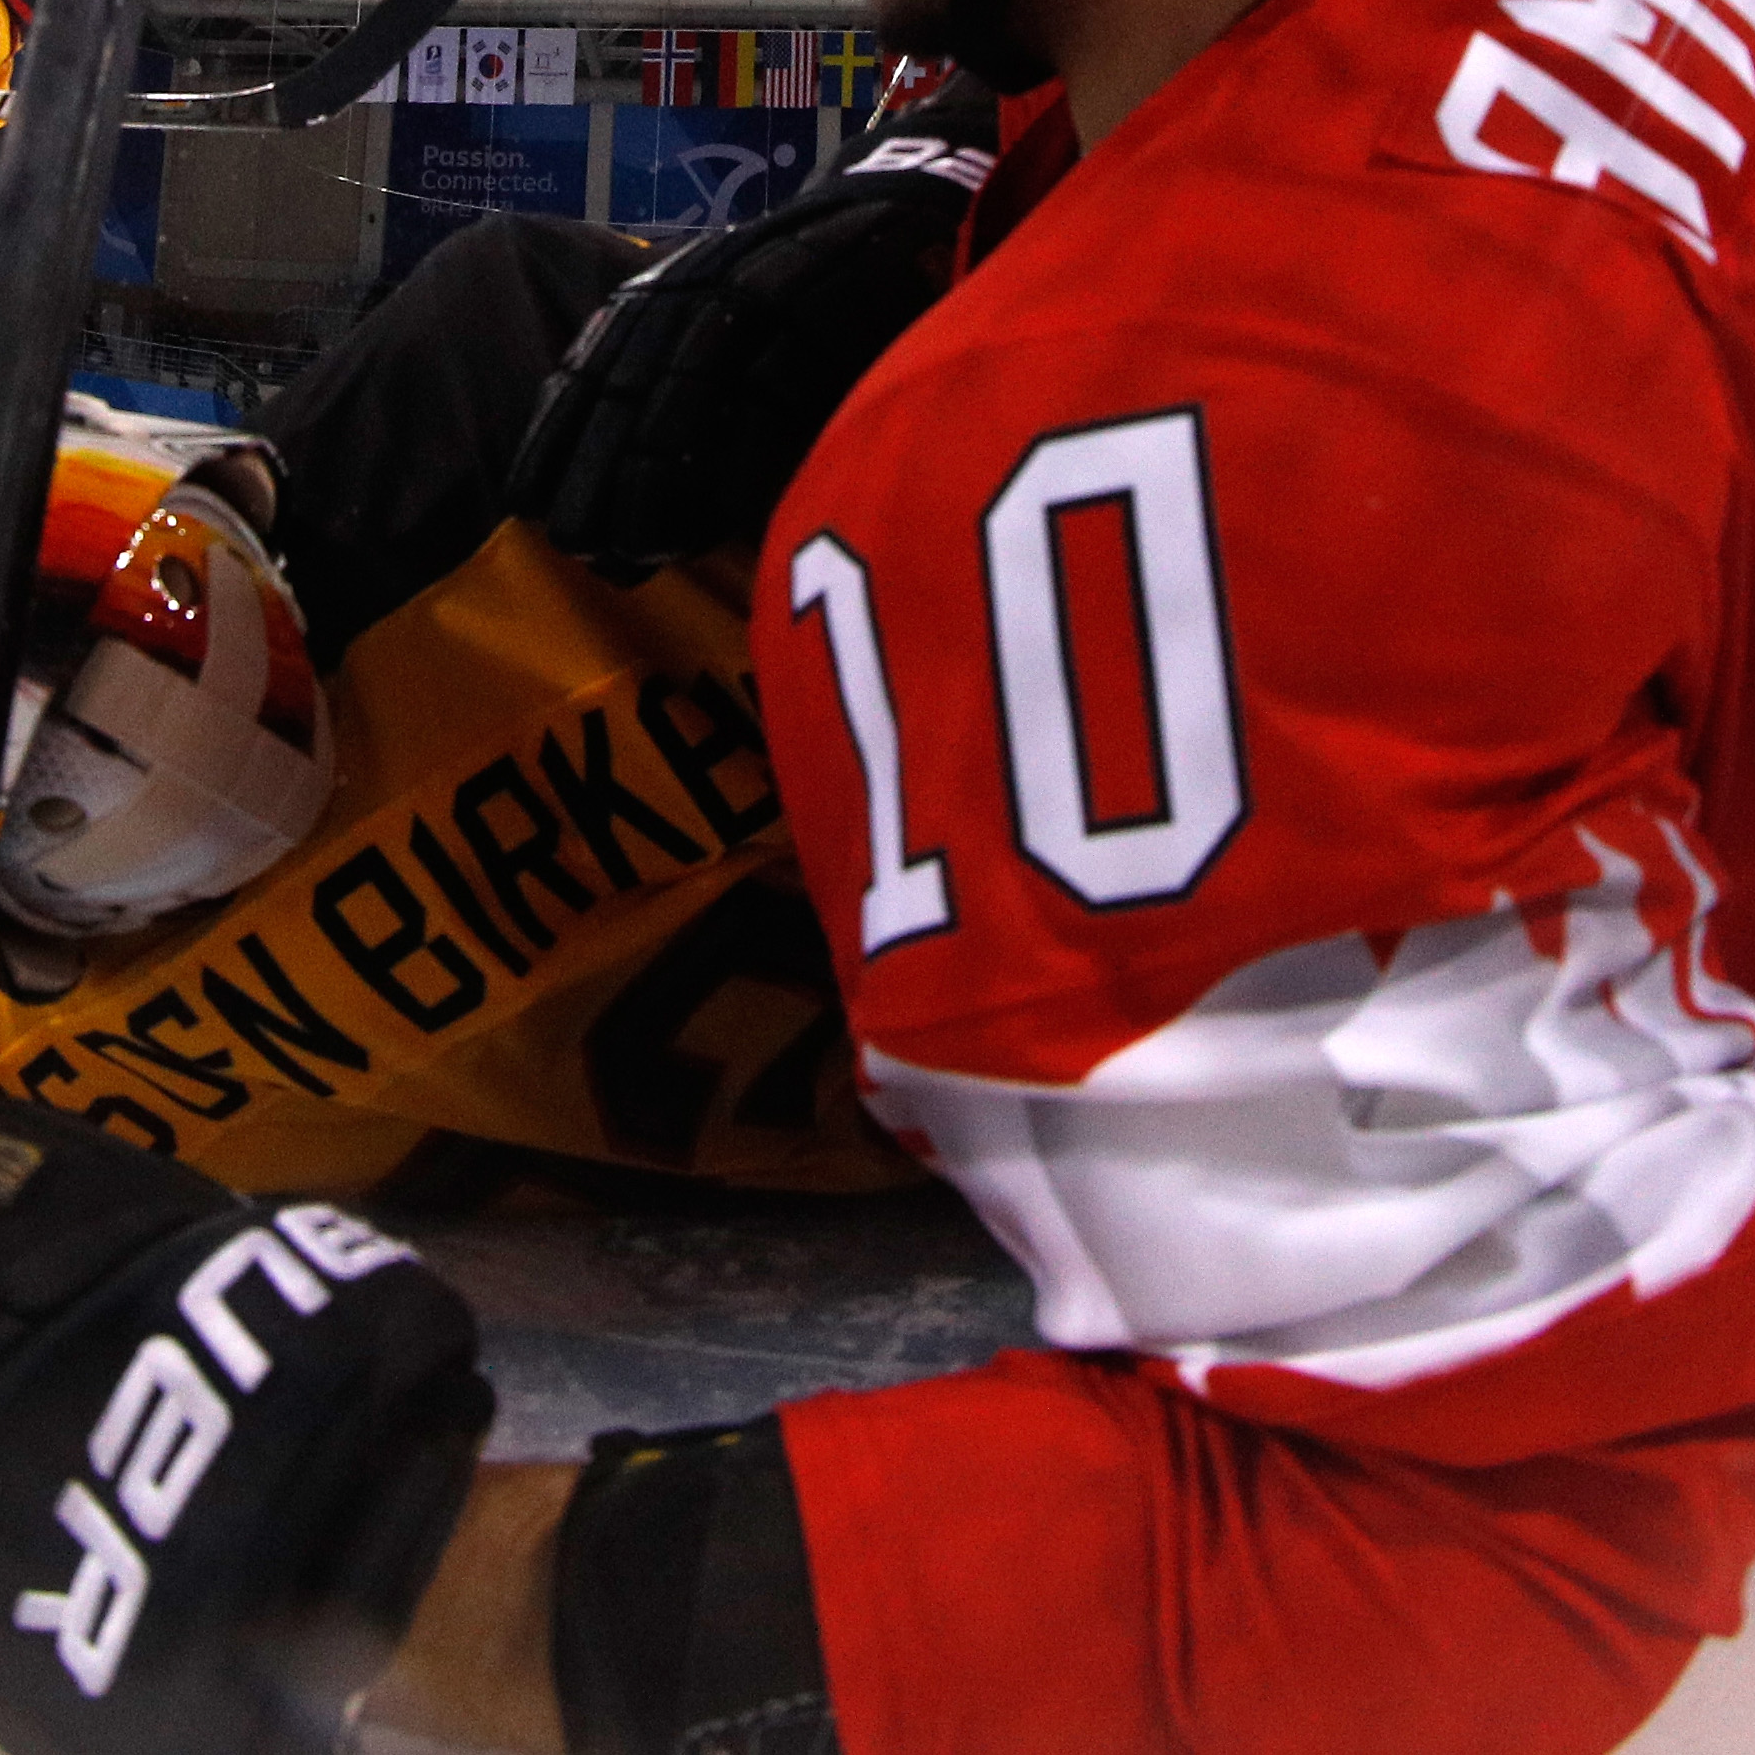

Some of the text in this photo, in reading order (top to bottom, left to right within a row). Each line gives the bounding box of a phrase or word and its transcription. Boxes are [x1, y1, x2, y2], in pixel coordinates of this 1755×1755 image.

[420, 168, 559, 194] Connected.
[422, 144, 532, 169] Passion.
[788, 401, 1254, 962] 10
[12, 1201, 427, 1699] AUER
